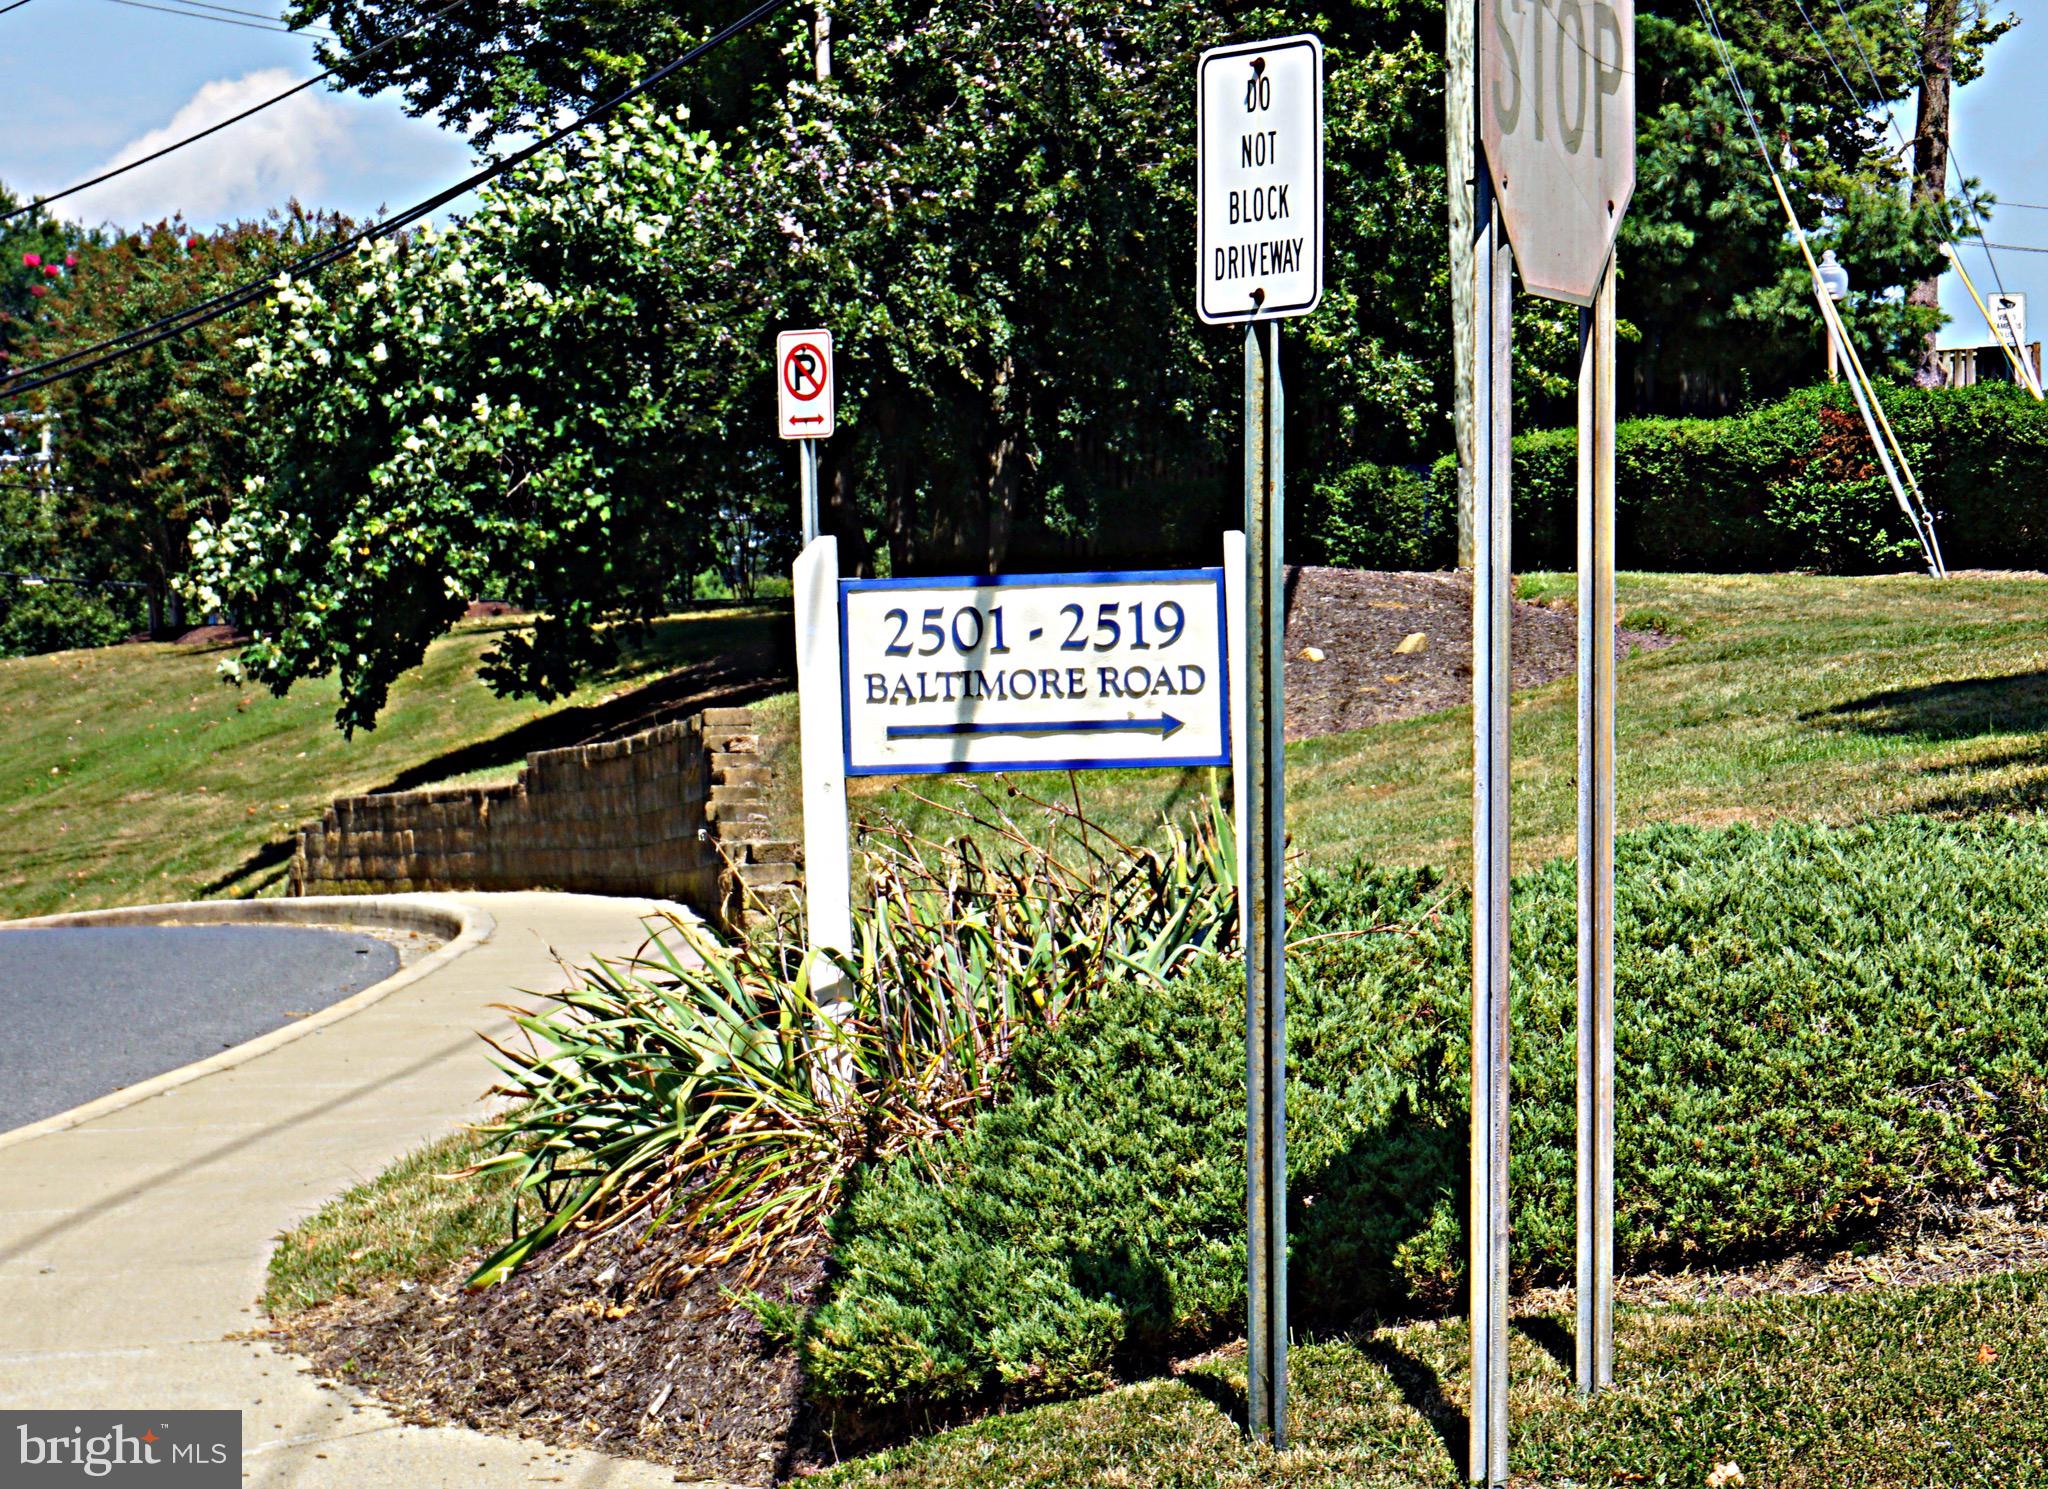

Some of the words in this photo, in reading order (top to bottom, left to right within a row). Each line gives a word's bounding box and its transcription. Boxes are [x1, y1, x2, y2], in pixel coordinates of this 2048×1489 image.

[1246, 76, 1270, 113] DO
[1492, 0, 1624, 159] STOP
[1241, 131, 1277, 168] NOT
[1229, 184, 1289, 225] BLOCK
[1215, 237, 1304, 281] DRIVEWAY
[883, 605, 1010, 657] 2501
[1060, 600, 1186, 653] 2519
[864, 667, 1088, 705] BALTIMORE
[1099, 664, 1206, 699] ROAD
